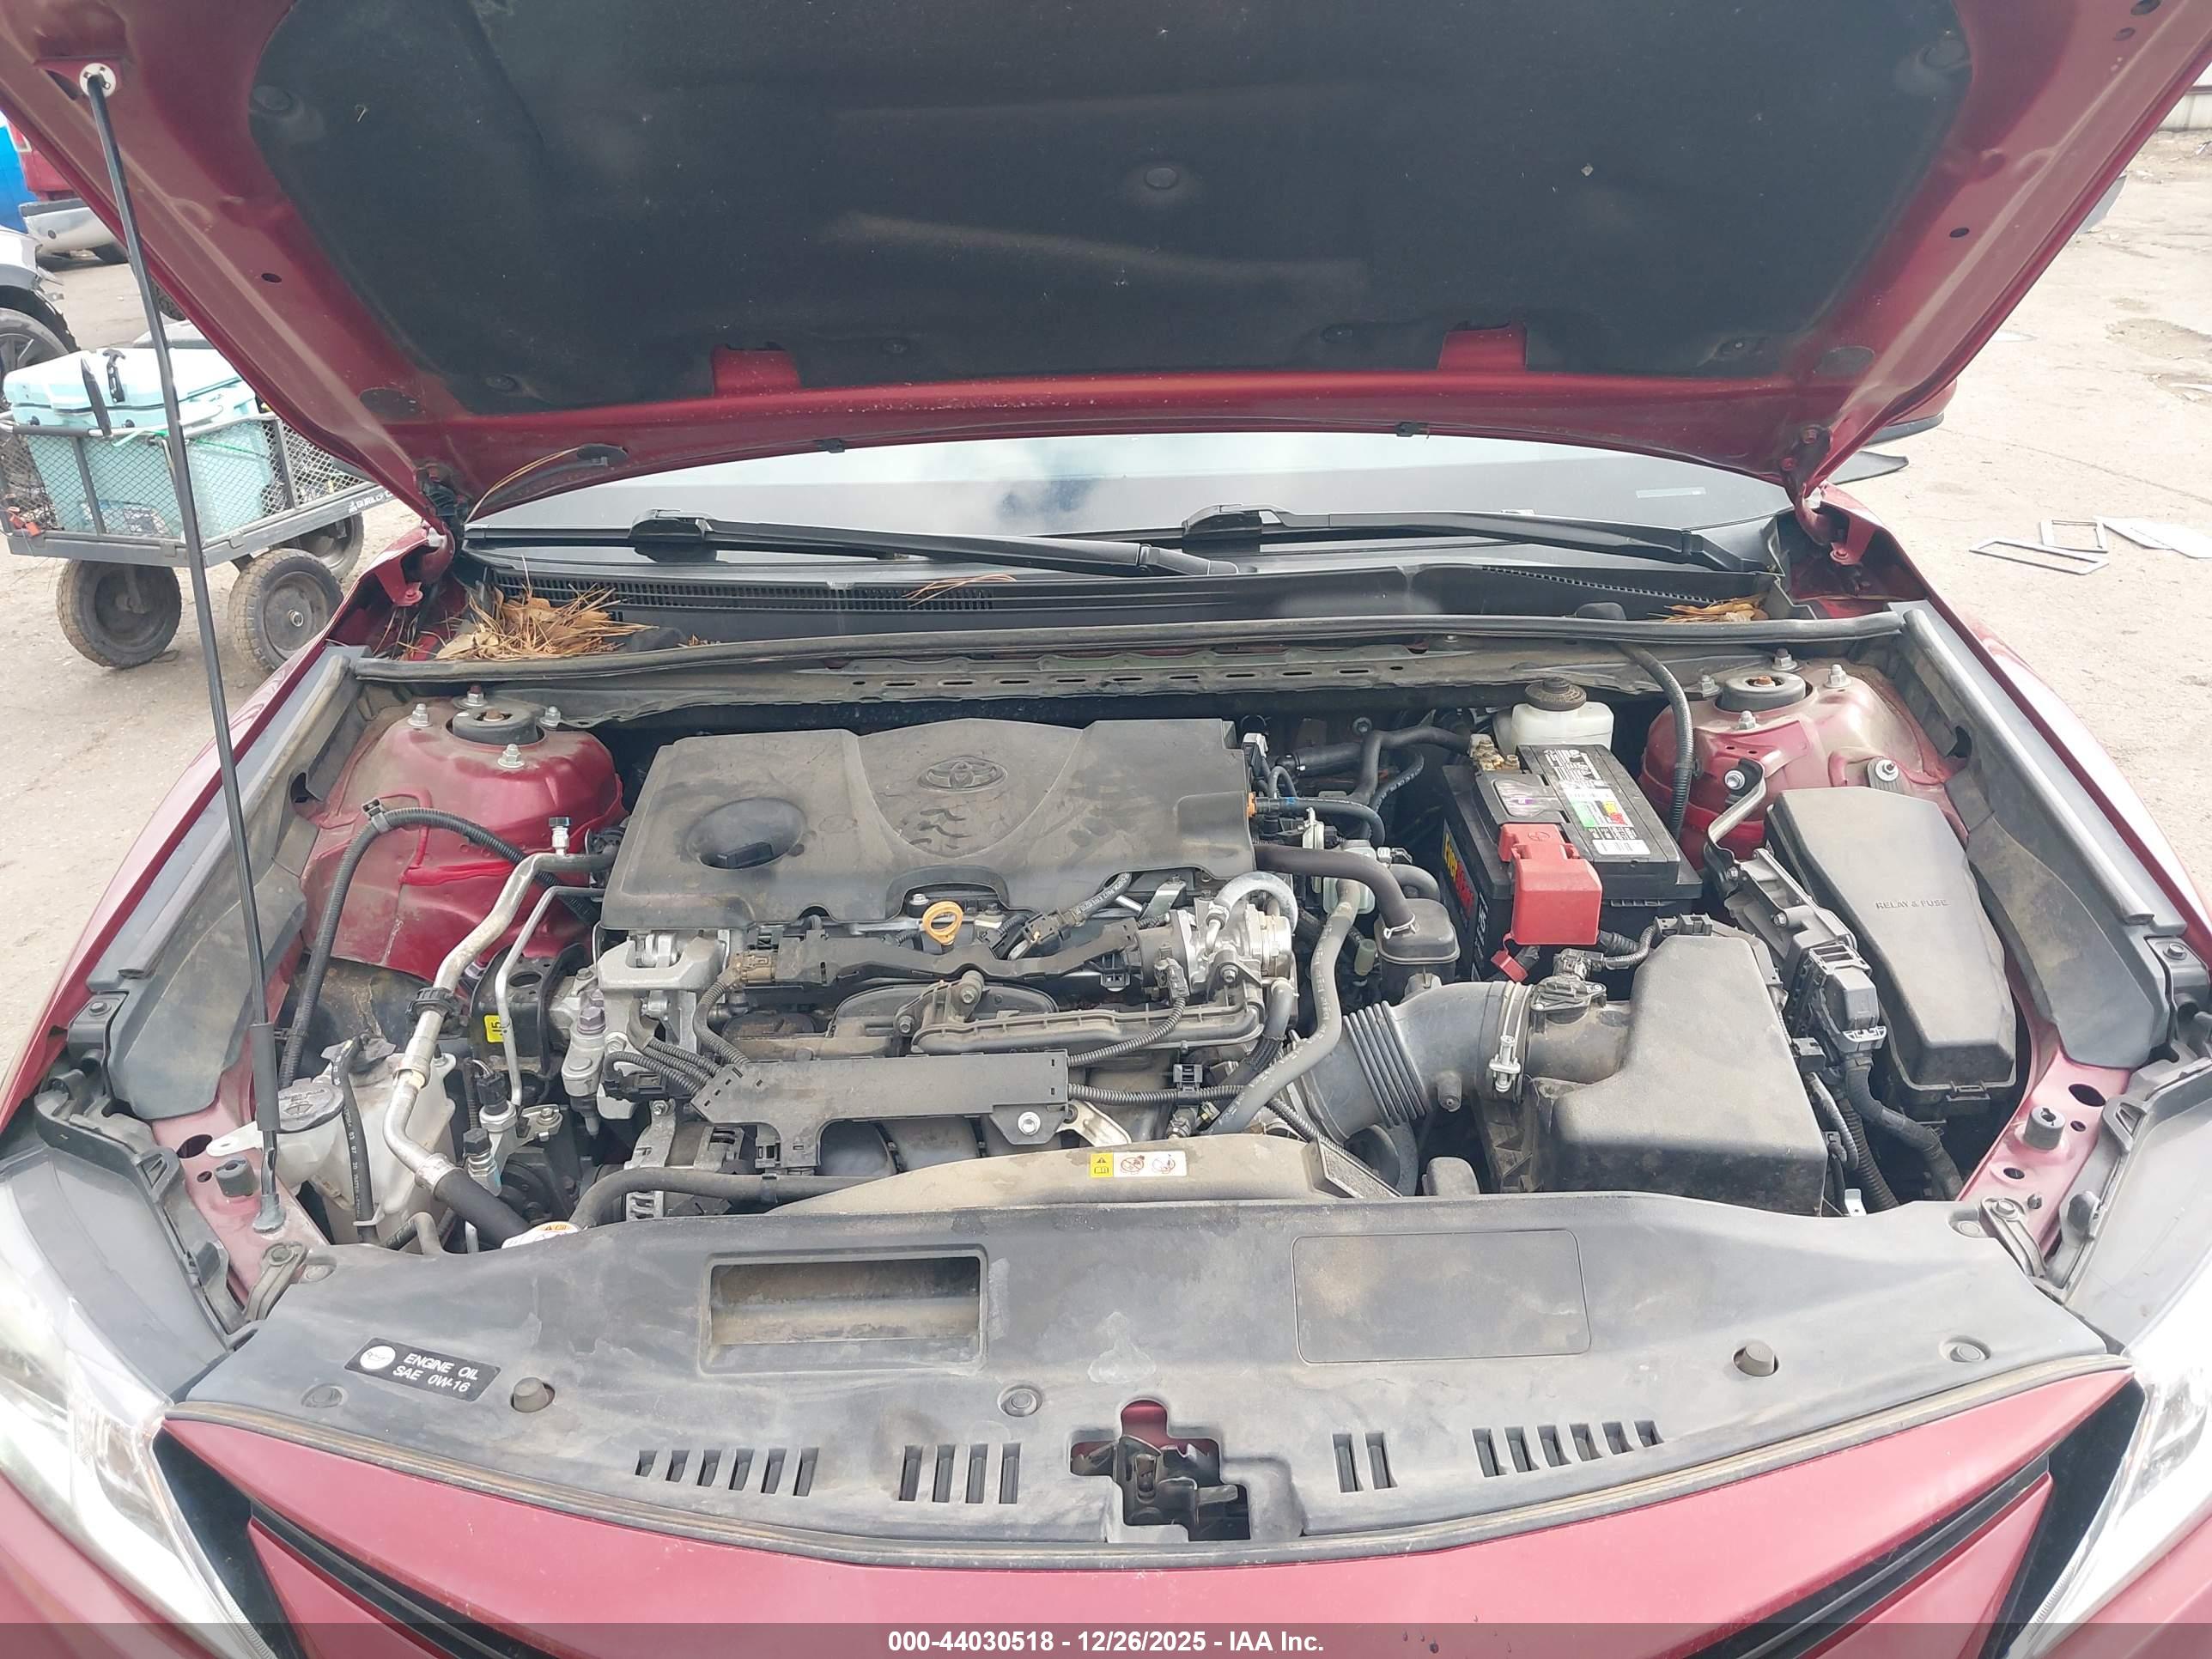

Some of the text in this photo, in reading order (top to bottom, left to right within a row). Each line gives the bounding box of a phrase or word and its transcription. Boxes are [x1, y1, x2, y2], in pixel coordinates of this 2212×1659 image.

[1875, 900, 1908, 909] RELAY
[1920, 899, 1951, 908] FUSE
[392, 1365, 471, 1392] SAE 0W-16
[404, 1352, 480, 1381] ENGINE OIL
